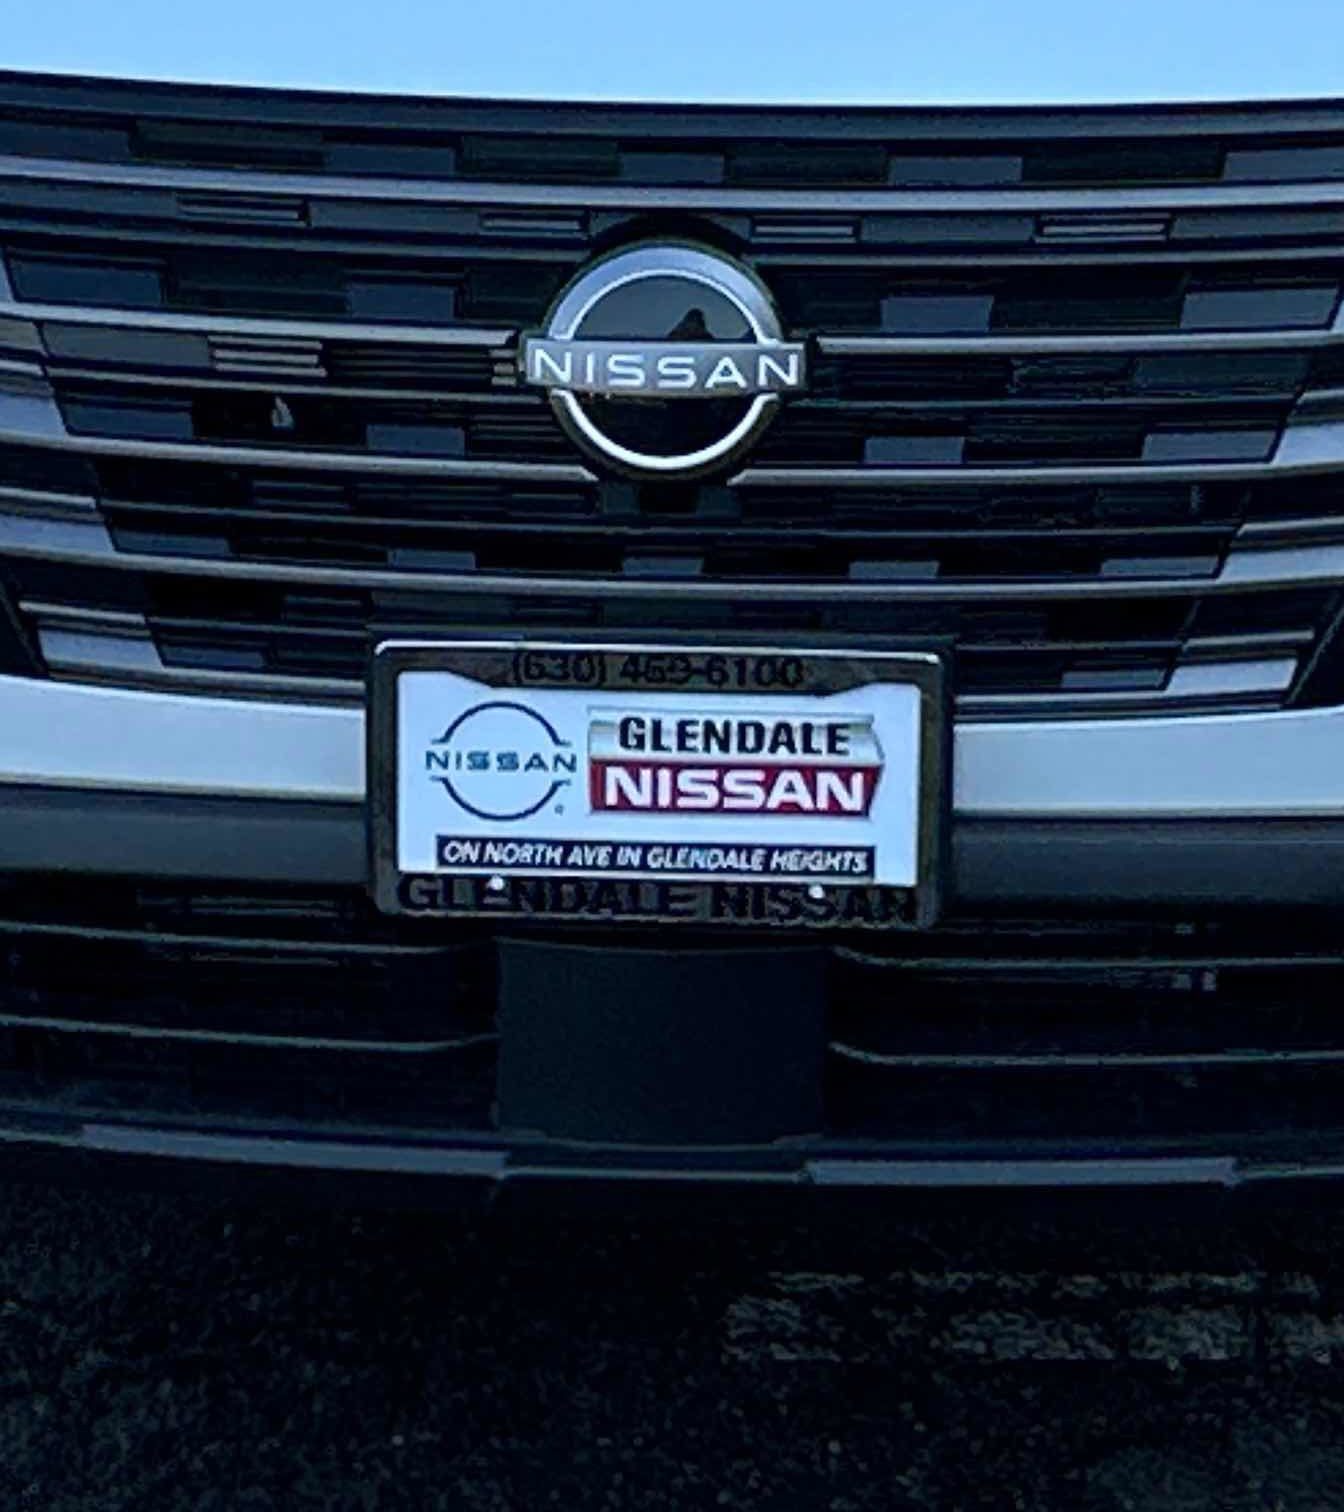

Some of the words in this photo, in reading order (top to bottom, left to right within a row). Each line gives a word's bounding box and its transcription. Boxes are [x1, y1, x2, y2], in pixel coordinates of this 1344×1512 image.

[533, 347, 800, 389] NISSAN
[617, 715, 852, 757] GLENDALE
[425, 749, 578, 774] NISSAN
[605, 765, 866, 813] NISSAN
[443, 840, 482, 865] ON
[483, 842, 563, 867] NORTH
[567, 845, 614, 869] AVE
[616, 846, 643, 869] IN
[646, 847, 765, 874] GLENDALE
[770, 850, 870, 875] HEIGHTS
[397, 872, 702, 919] GLENDALE
[710, 879, 922, 929] NISSAN
